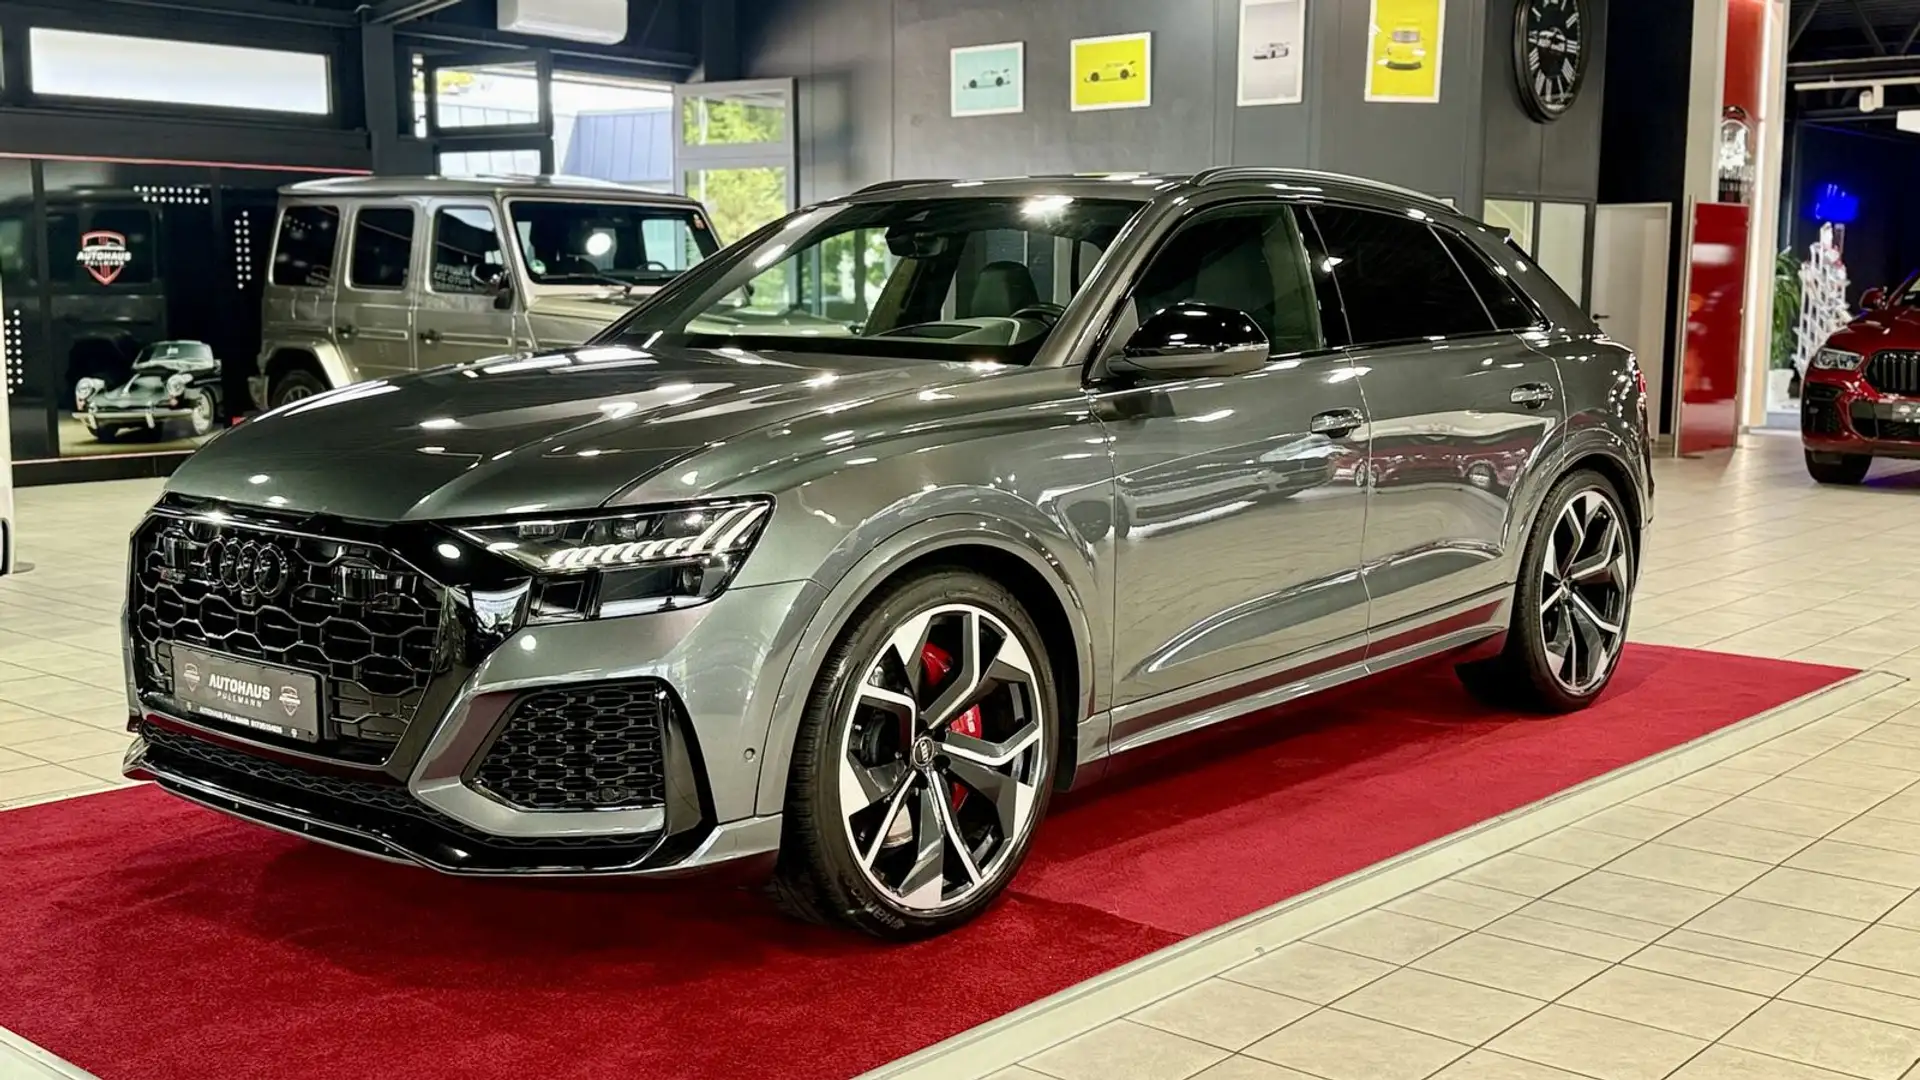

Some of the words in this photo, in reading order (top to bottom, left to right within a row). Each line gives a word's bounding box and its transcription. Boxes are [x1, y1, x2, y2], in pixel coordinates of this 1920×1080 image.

[76, 251, 132, 261] AUTOHAUS
[208, 673, 271, 700] AUTOHAUS
[217, 691, 263, 708] PULLMANN
